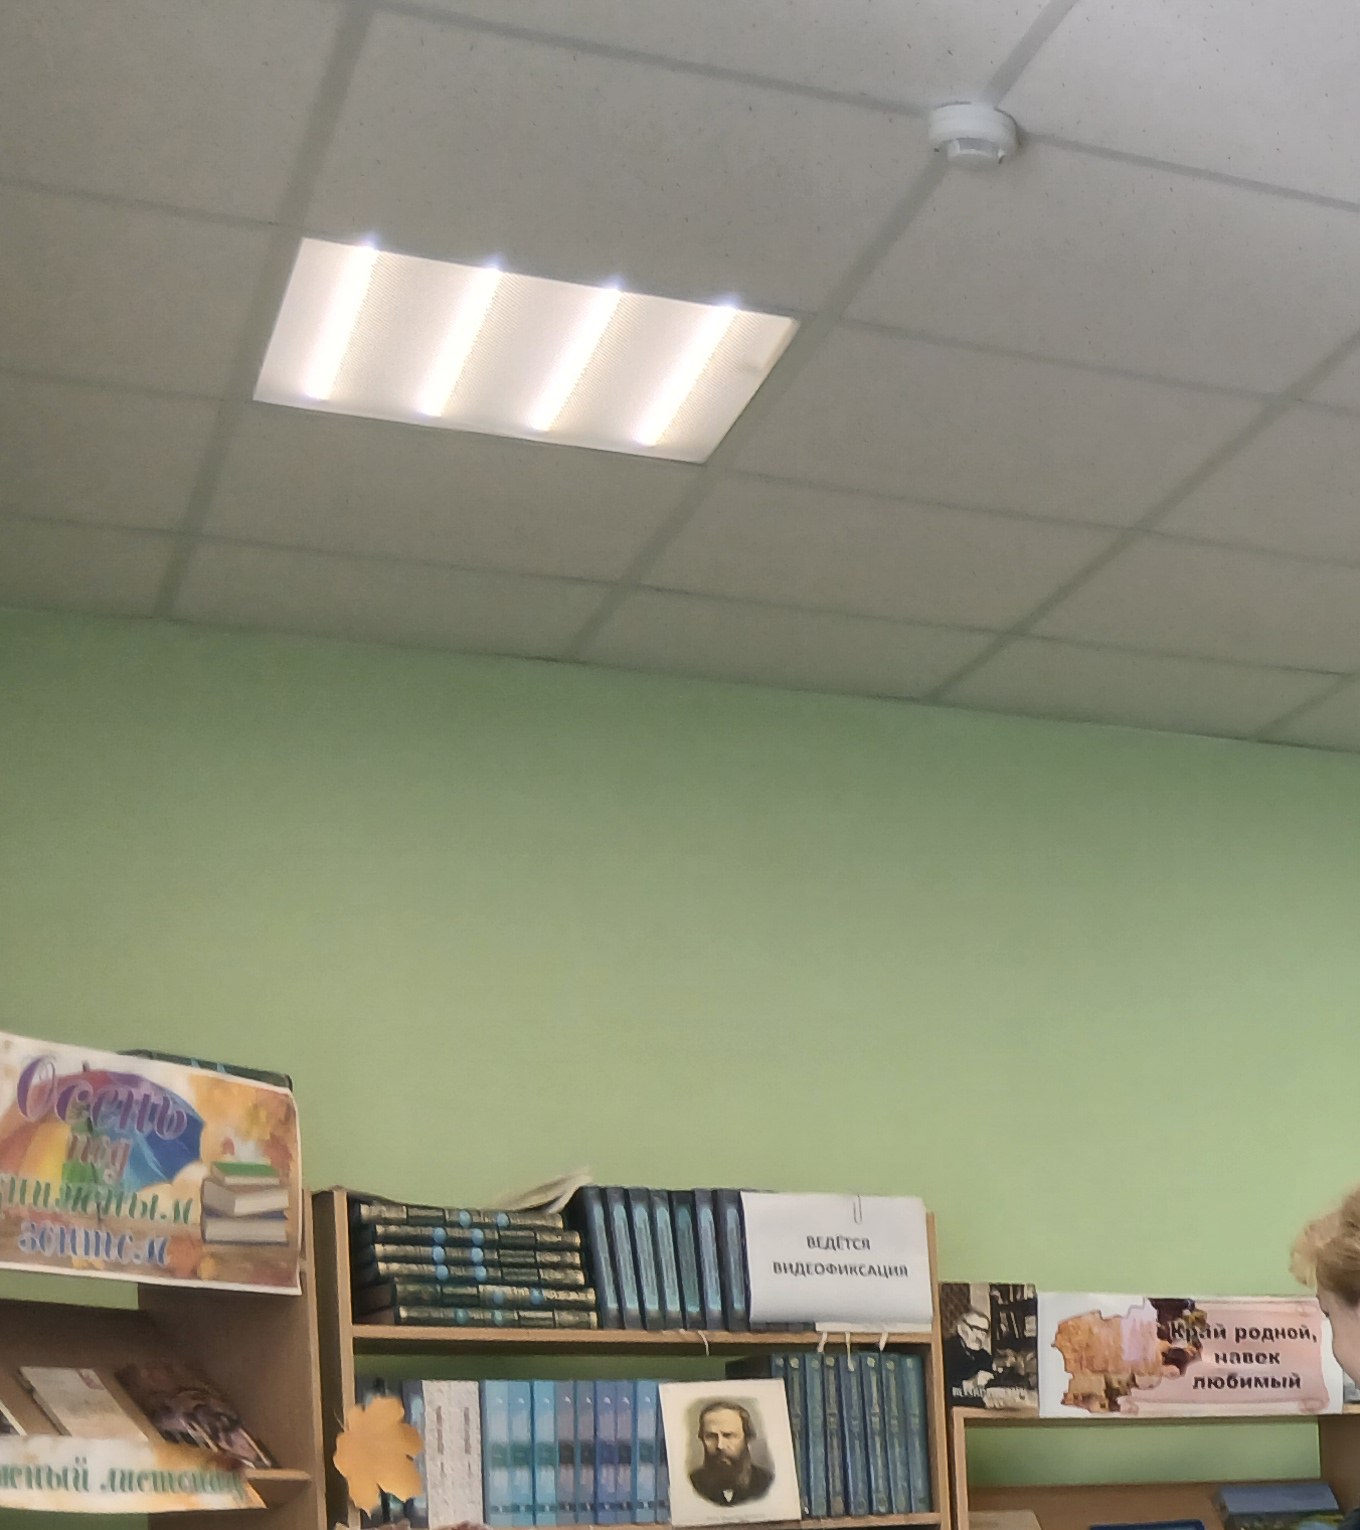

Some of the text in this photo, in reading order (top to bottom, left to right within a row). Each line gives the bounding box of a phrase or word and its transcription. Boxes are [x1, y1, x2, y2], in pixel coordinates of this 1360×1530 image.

[17, 1055, 188, 1140] Осень
[0, 1174, 193, 1224] нижным
[806, 1234, 871, 1251] ВЕДЁТСЯ
[772, 1261, 909, 1279] ВИДЕОФИКСАЦИЯ
[1171, 1321, 1318, 1343] Край родной,
[1214, 1352, 1280, 1365] навек
[1192, 1373, 1302, 1391] любимый
